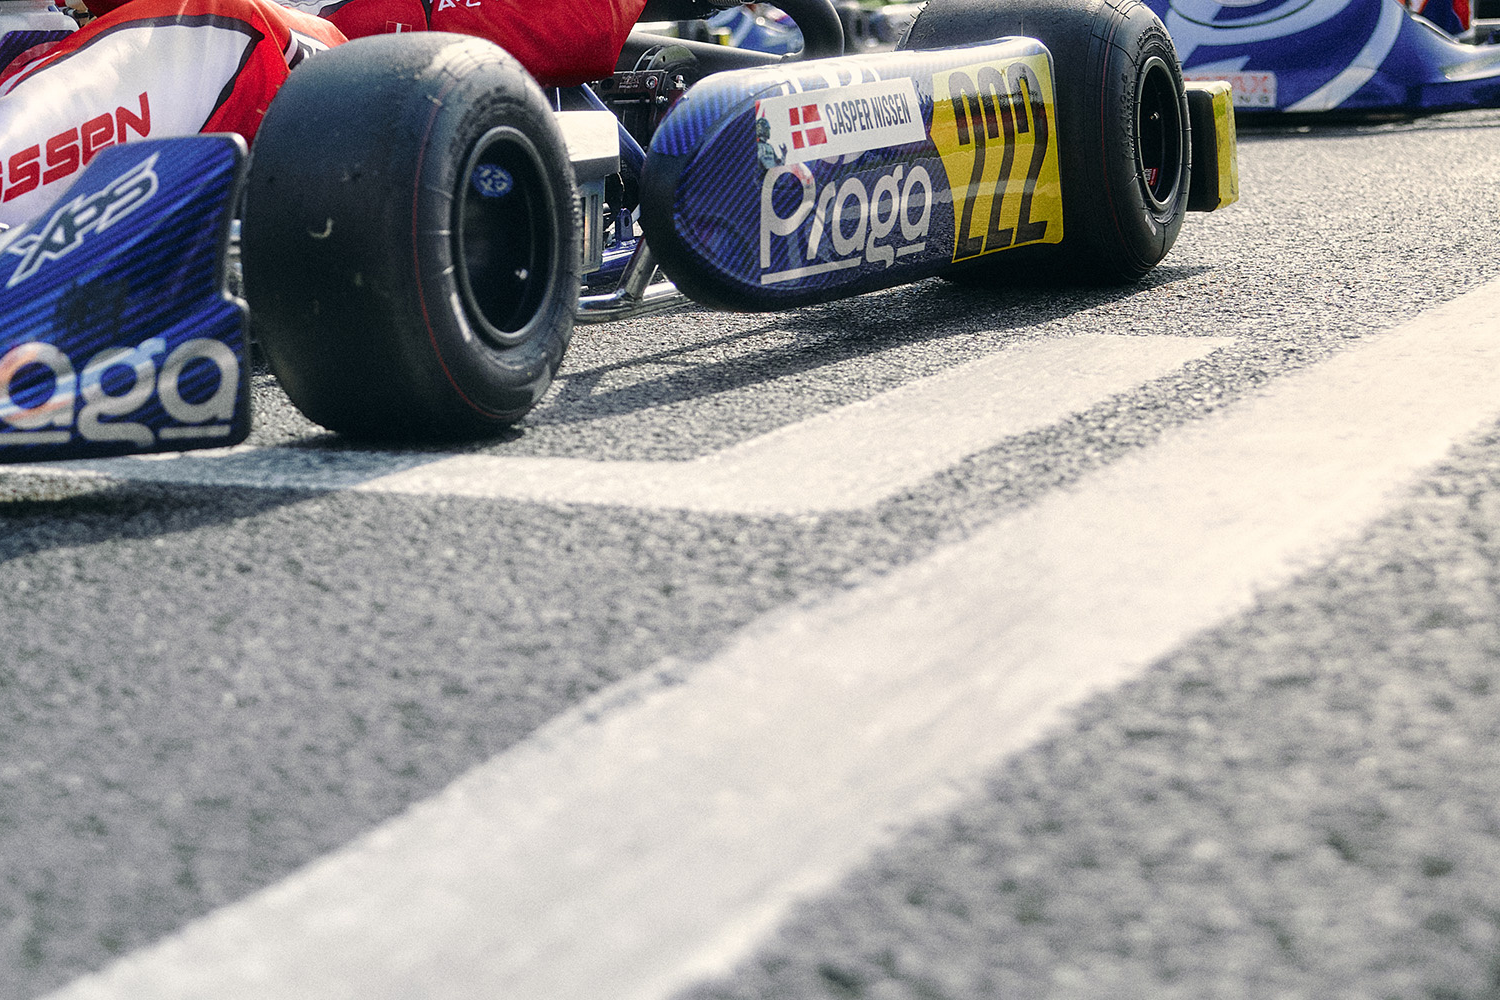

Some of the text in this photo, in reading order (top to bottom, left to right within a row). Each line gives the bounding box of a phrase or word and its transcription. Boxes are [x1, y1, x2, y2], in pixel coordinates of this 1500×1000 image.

[825, 92, 912, 135] CASPER NISSEN
[950, 62, 1049, 262] 222
[6, 151, 160, 289] XPS
[760, 162, 933, 285] Praga
